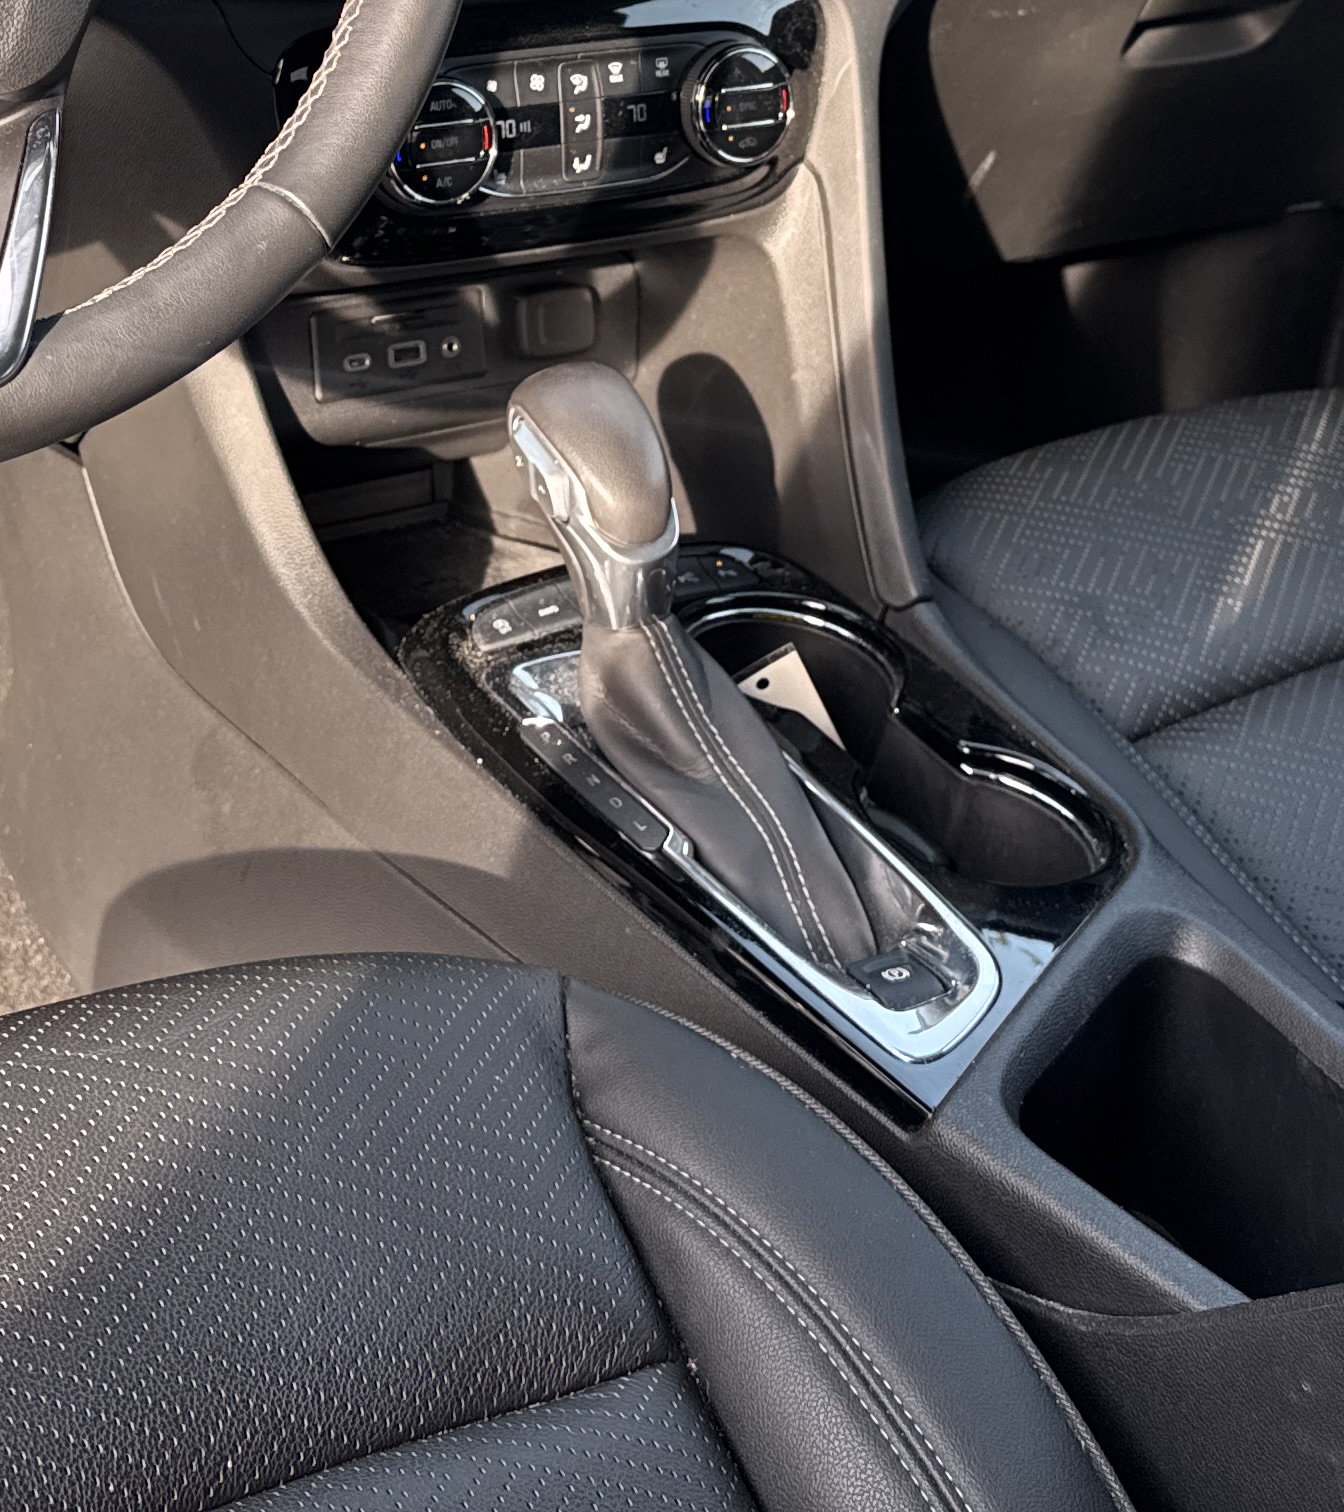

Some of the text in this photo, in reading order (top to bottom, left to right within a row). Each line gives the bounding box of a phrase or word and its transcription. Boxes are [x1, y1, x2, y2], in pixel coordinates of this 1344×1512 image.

[430, 99, 453, 112] AUTO
[626, 103, 647, 123] 70
[496, 119, 516, 139] 70
